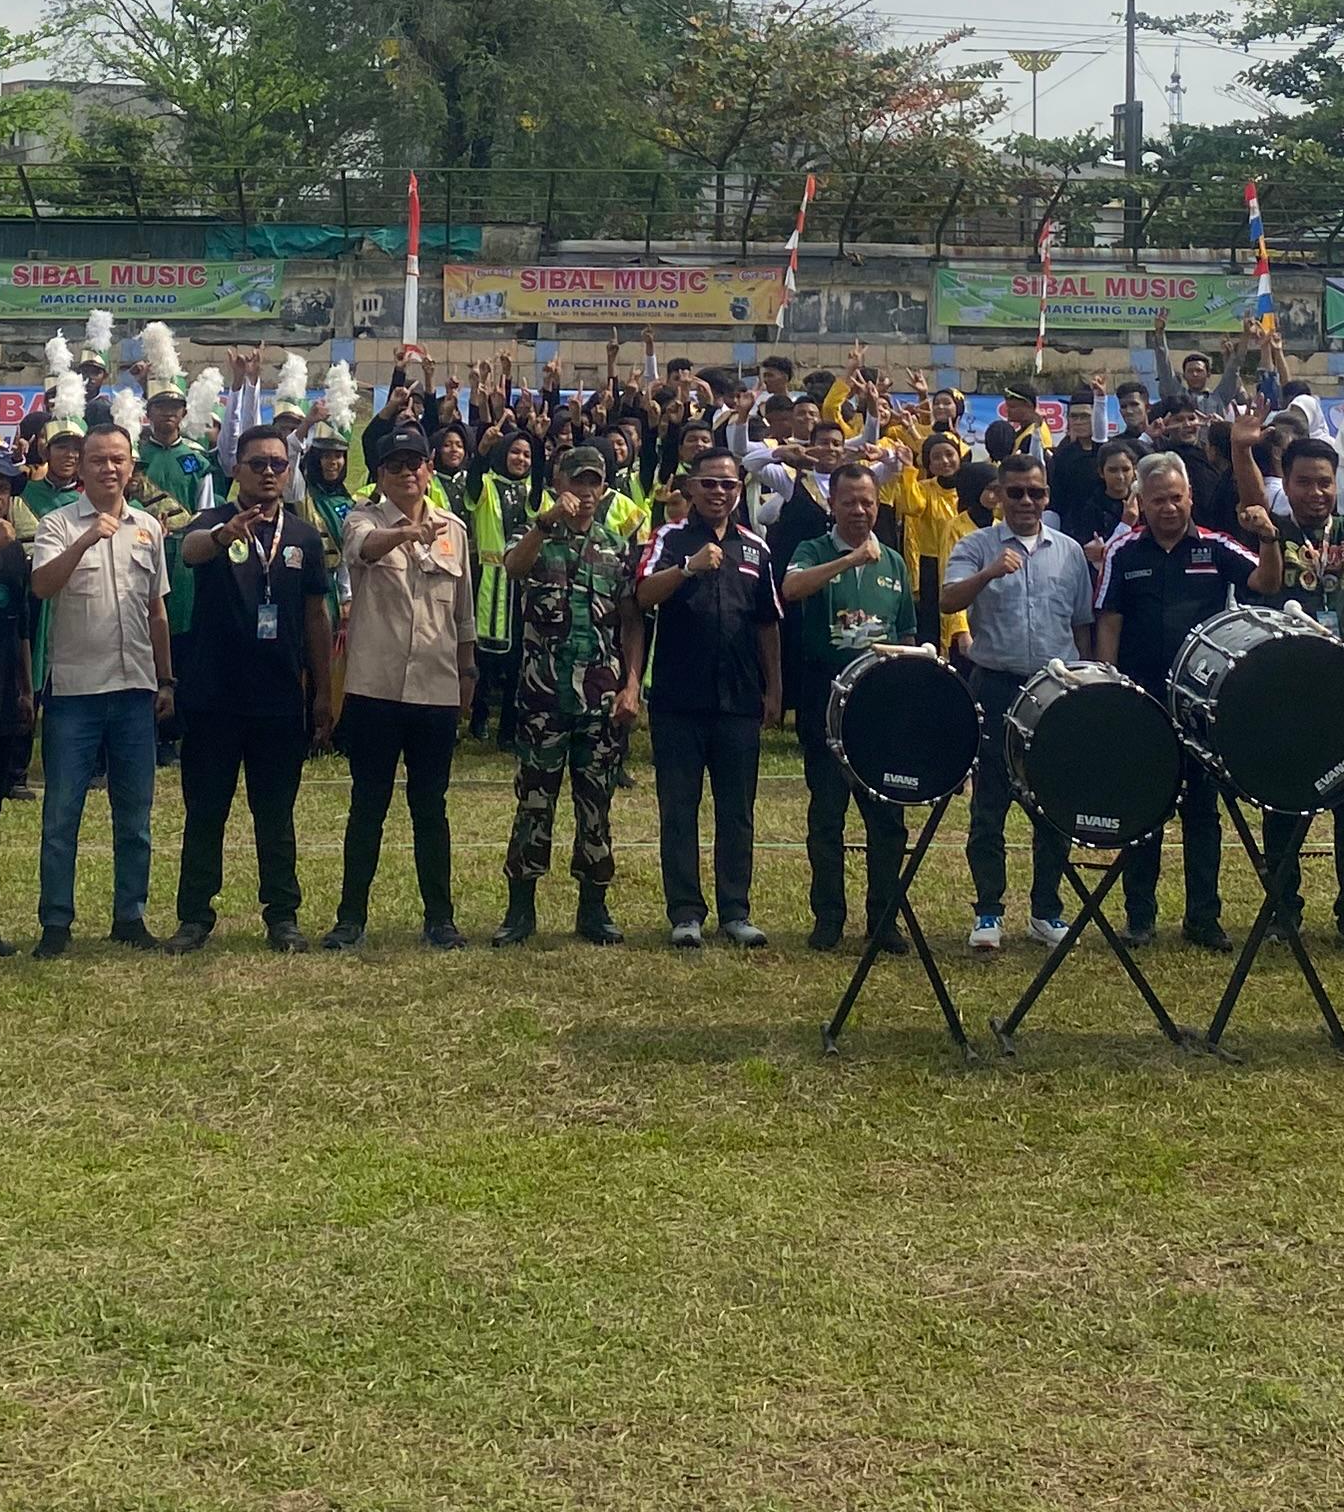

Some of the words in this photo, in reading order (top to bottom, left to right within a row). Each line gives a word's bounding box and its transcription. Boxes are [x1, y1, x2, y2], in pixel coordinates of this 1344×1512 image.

[13, 264, 100, 286] SIBAL
[111, 265, 207, 287] MUSIC
[520, 270, 605, 291] SIBAL
[614, 271, 709, 293] MUSIC
[1011, 275, 1096, 297] SIBAL
[1105, 277, 1198, 300] MUSIC
[40, 295, 126, 304] MARCHING
[133, 294, 177, 304] BAND
[547, 299, 631, 308] MARCHING
[637, 299, 679, 309] BAND
[1128, 307, 1165, 316] BAN
[884, 773, 918, 786] EVANS
[1076, 814, 1120, 828] EVANS
